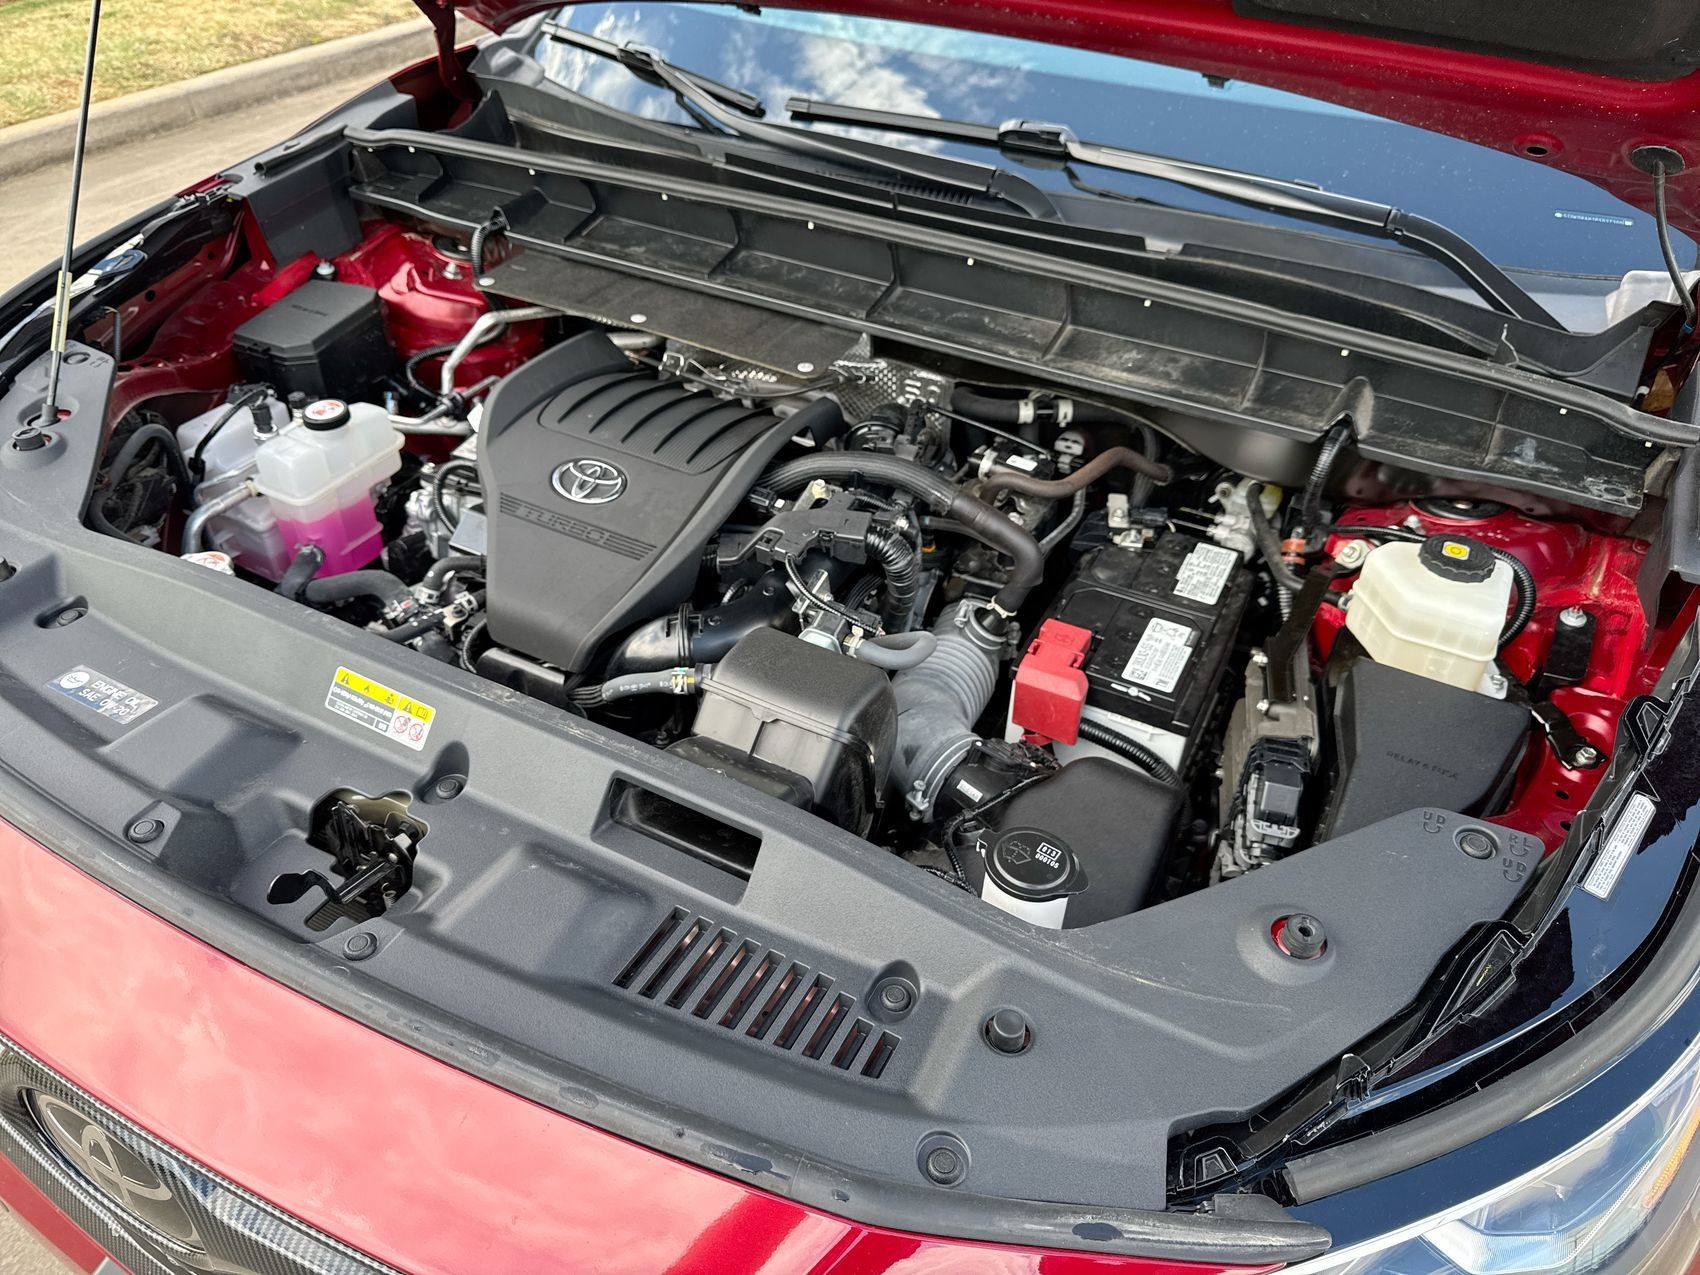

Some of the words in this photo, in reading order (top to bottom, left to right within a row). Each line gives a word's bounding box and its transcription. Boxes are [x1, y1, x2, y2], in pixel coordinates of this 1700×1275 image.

[520, 503, 608, 543] TURBO
[79, 688, 102, 702] SAE
[90, 680, 128, 699] ENGINE
